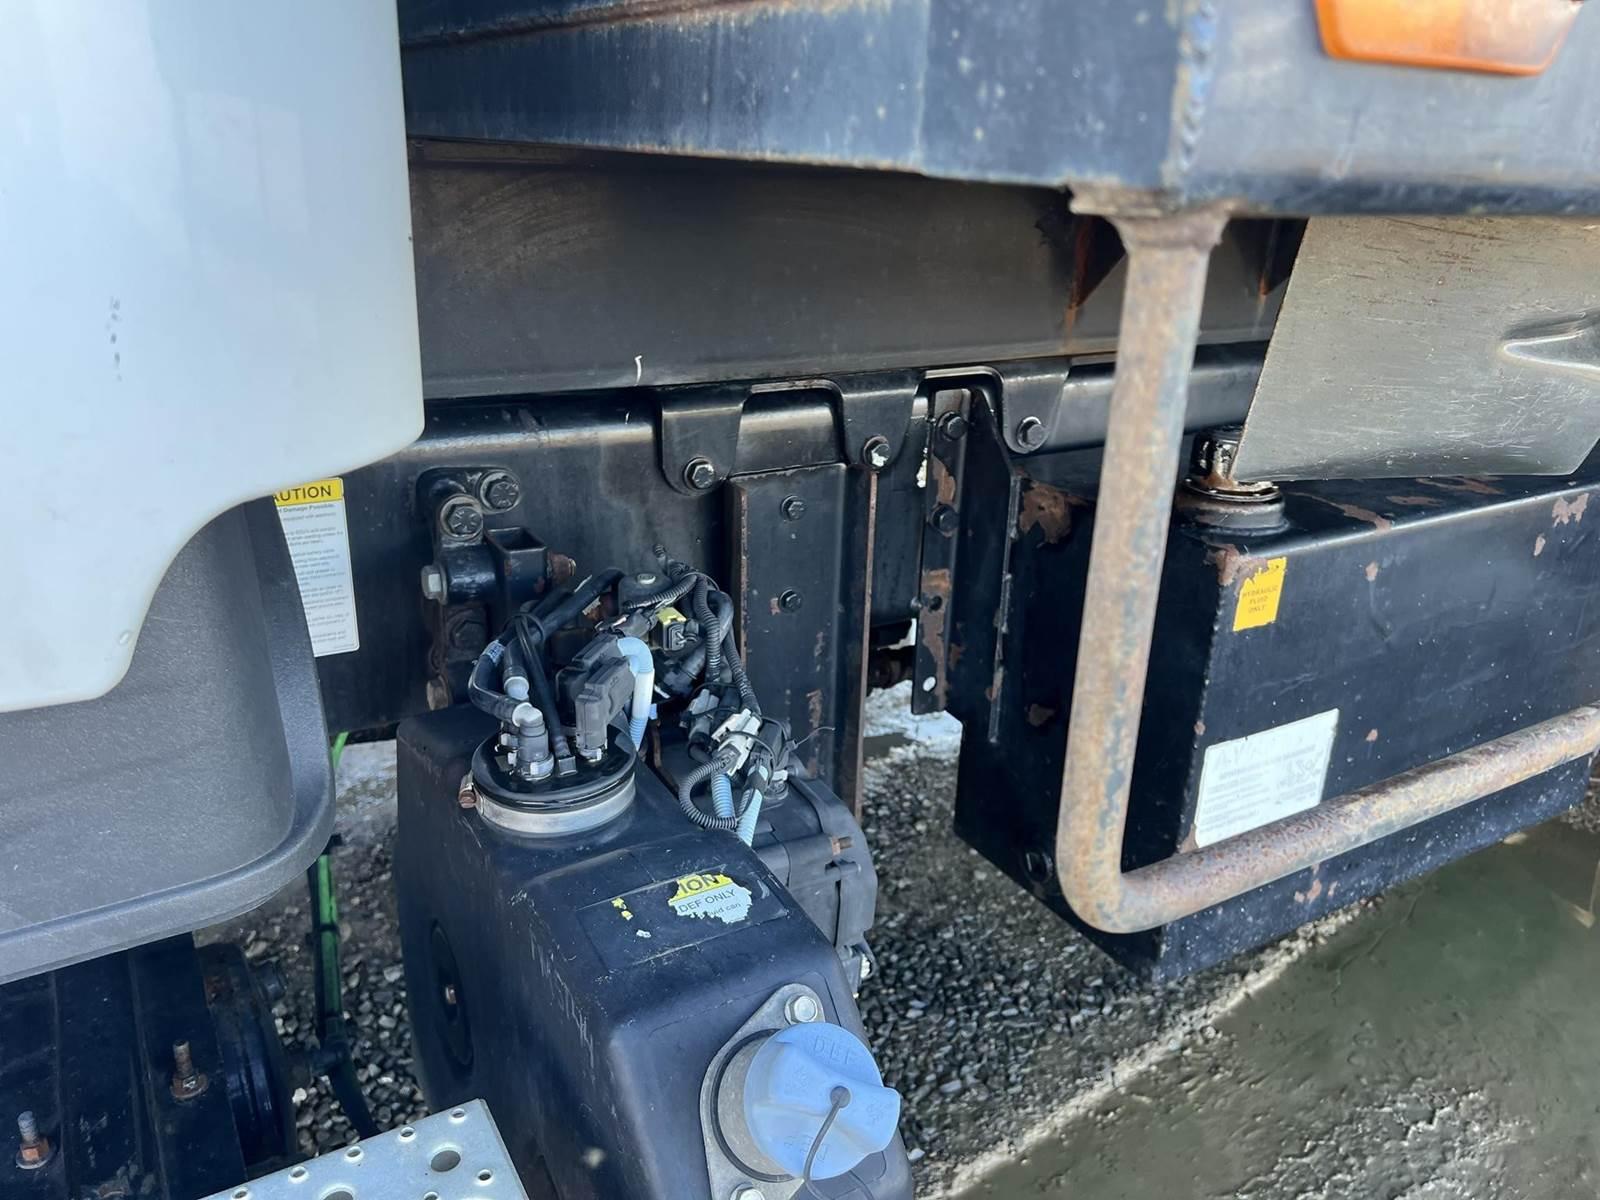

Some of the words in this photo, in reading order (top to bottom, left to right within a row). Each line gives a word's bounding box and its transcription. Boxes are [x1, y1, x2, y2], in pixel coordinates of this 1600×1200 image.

[678, 899, 702, 913] DEF
[705, 888, 736, 904] ONLY
[725, 902, 741, 911] can
